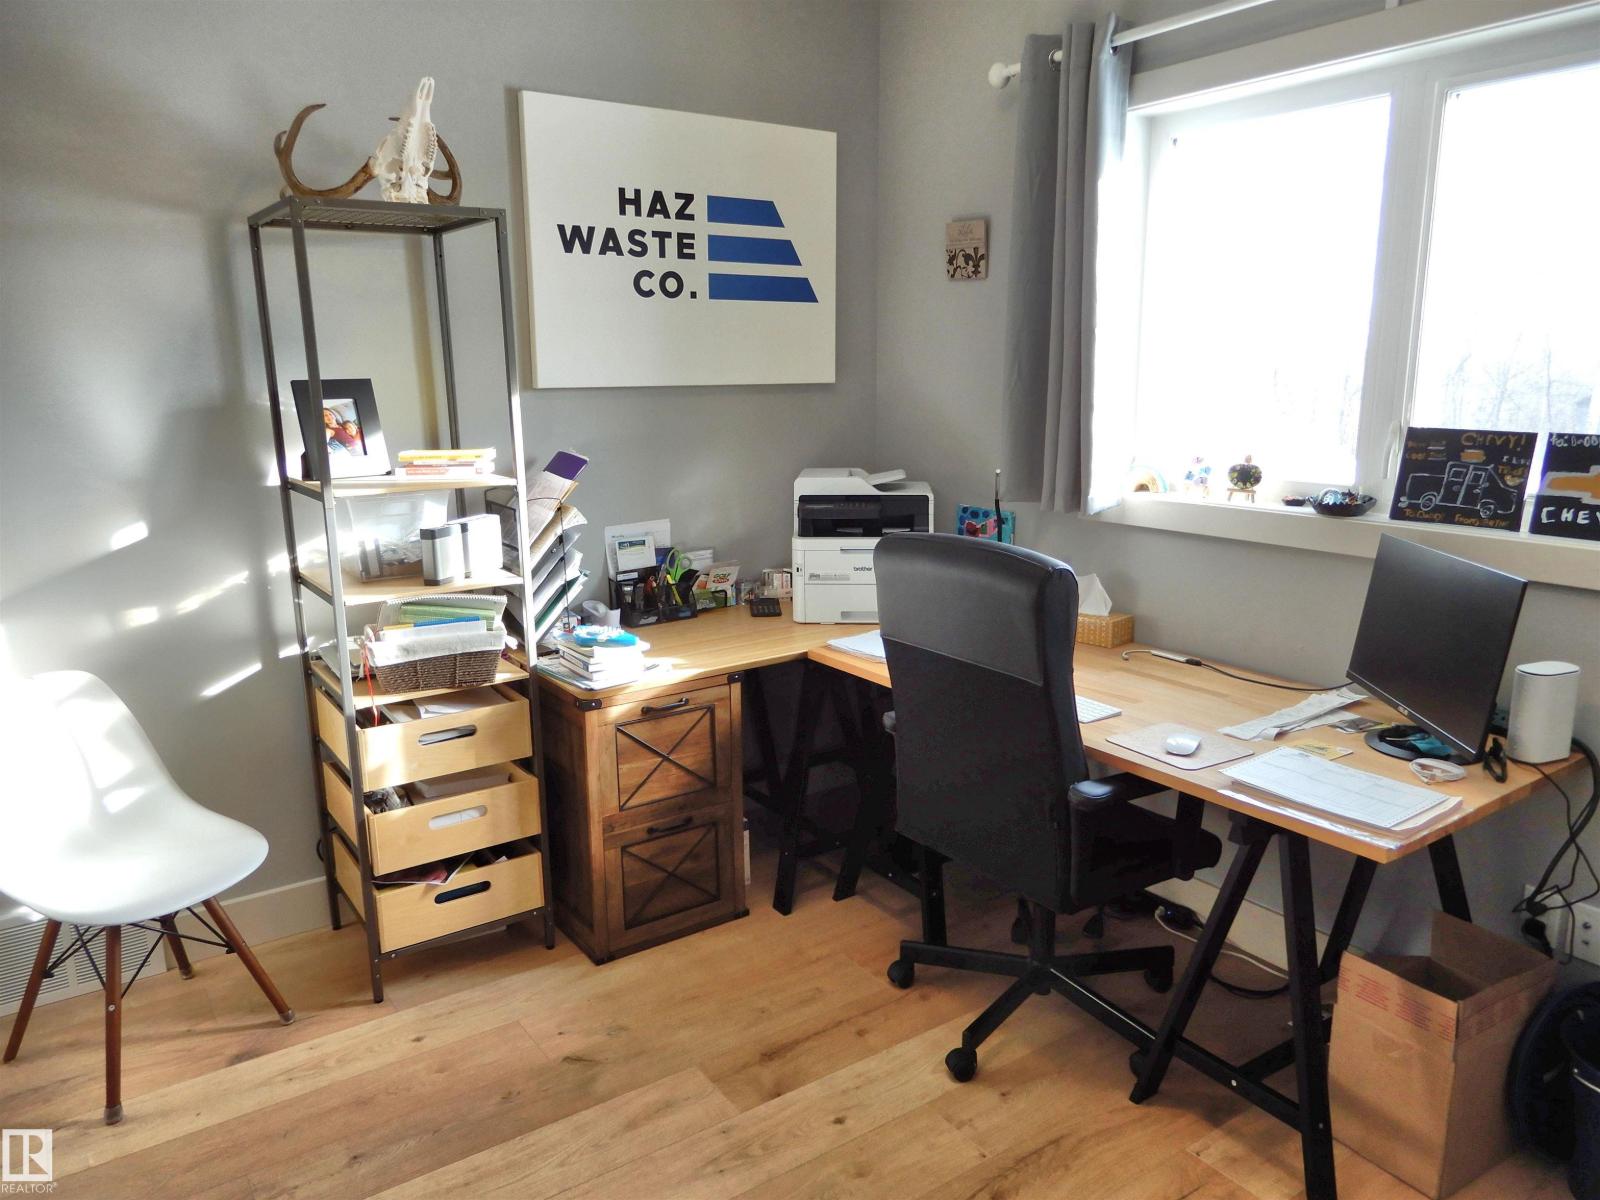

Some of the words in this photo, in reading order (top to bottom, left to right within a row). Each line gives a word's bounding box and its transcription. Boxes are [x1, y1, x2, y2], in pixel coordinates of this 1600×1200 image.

[618, 187, 696, 221] HAZ
[557, 224, 696, 260] WASTE
[633, 269, 698, 300] CO.
